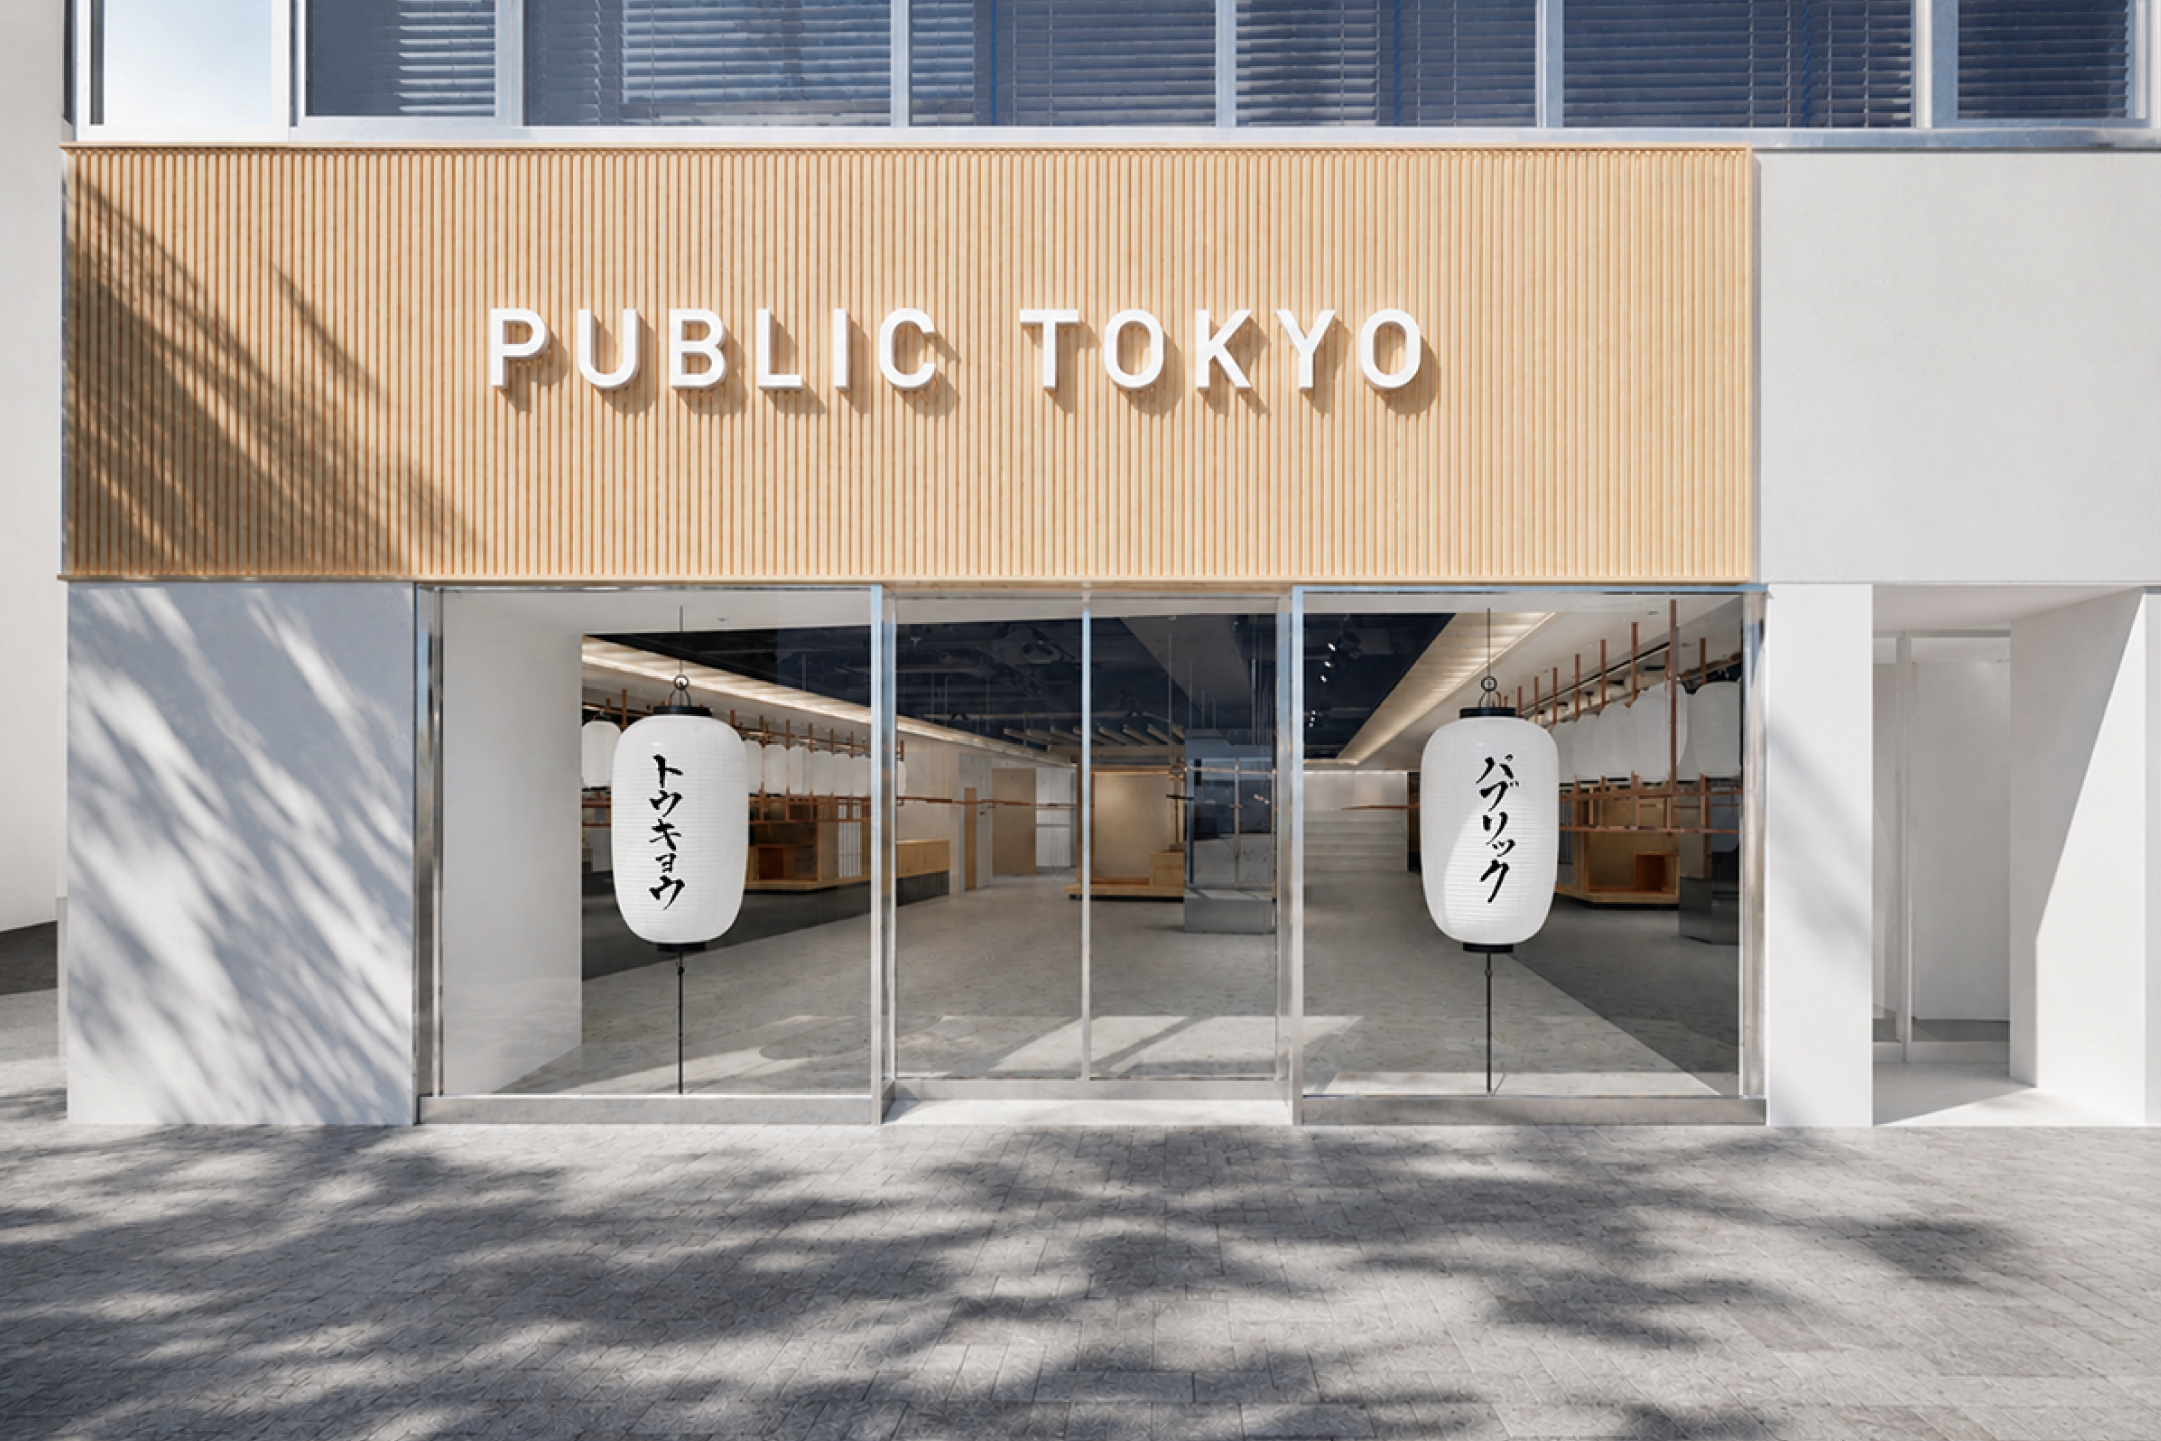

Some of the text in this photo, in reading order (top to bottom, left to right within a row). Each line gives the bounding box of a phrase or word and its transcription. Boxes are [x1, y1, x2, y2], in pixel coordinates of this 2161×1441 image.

[490, 307, 1423, 391] PUBLIC TOKYO
[649, 753, 686, 911] トウキョウ
[1475, 753, 1520, 903] パブリック
